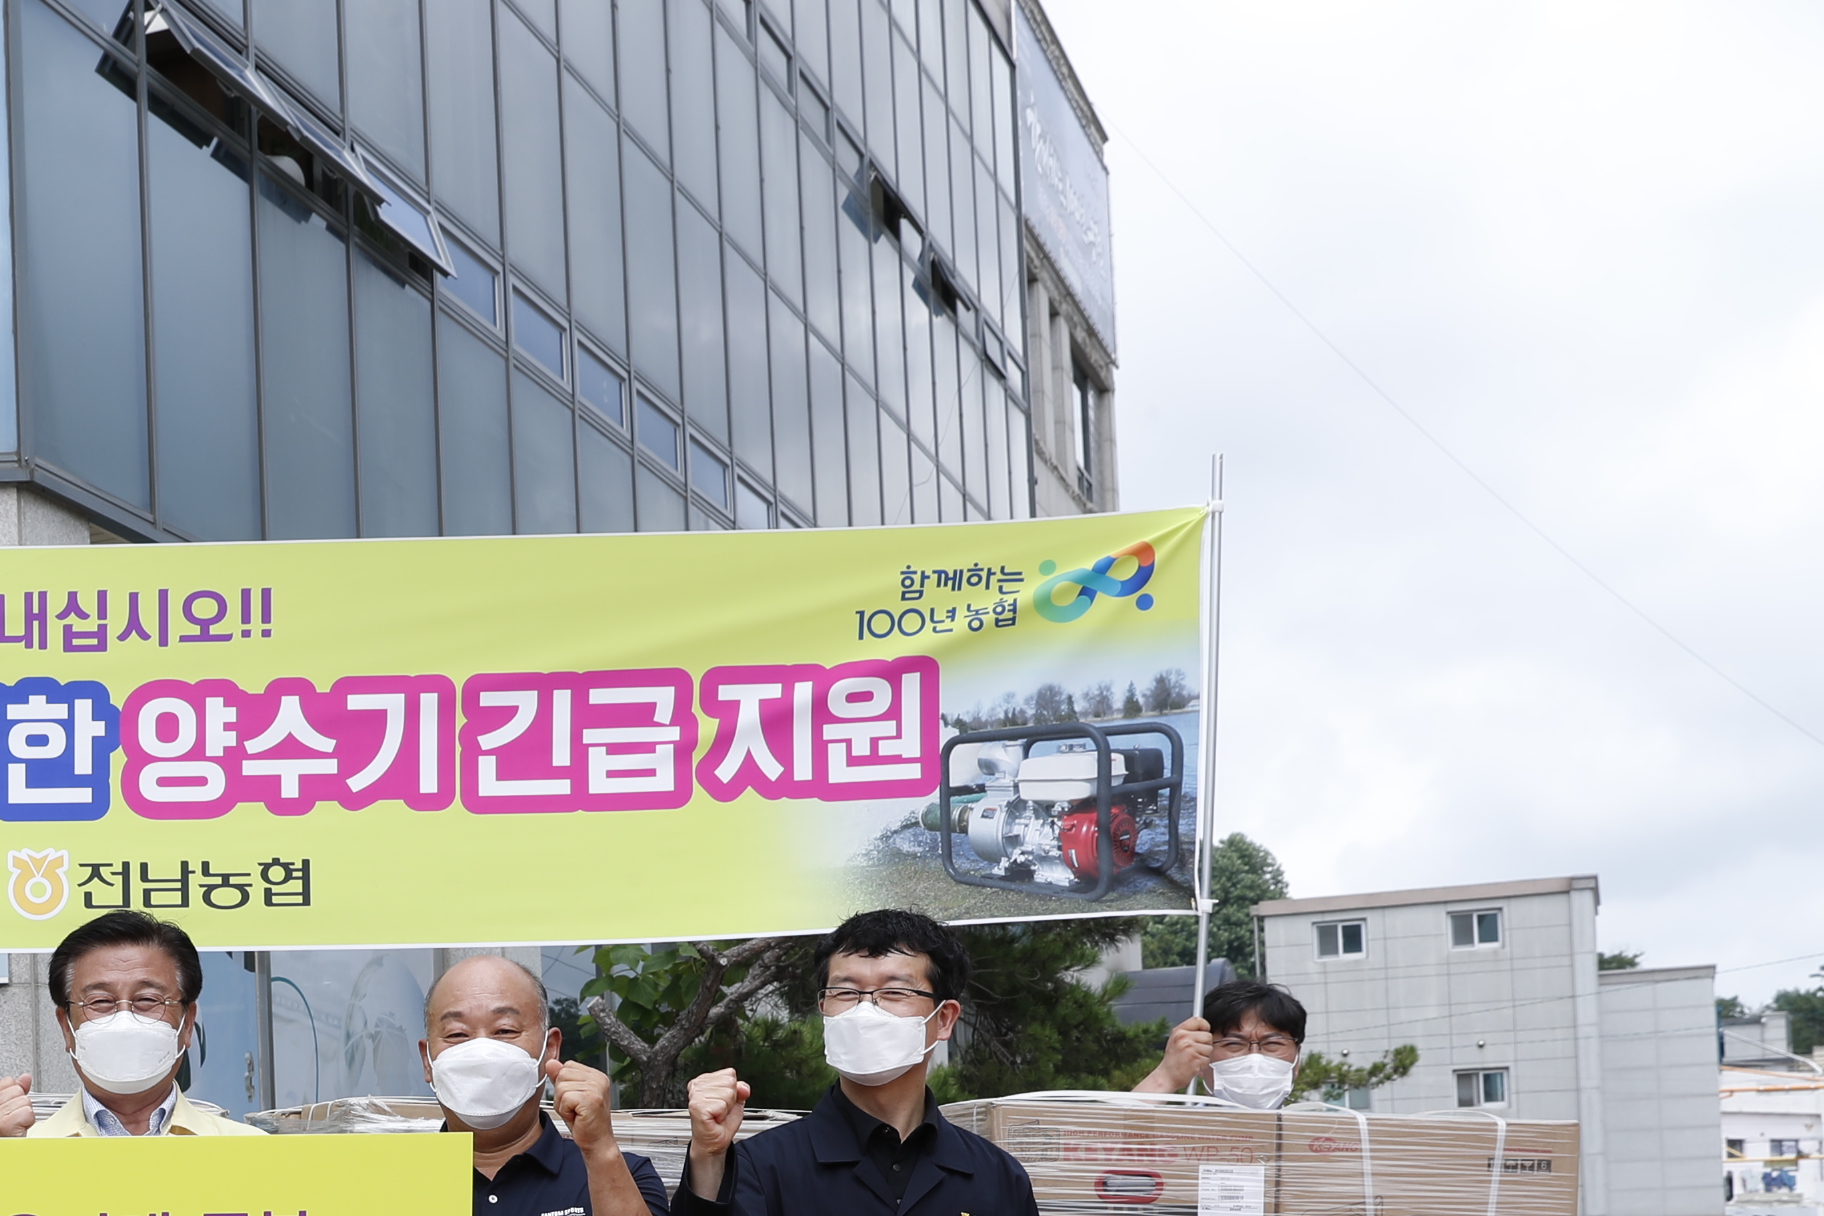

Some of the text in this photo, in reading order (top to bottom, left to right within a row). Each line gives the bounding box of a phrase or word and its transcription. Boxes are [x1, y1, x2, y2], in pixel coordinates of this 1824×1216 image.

[899, 562, 1025, 602] 함께하는
[855, 597, 1018, 642] 100년 농협
[135, 691, 440, 803] 양수기
[476, 685, 682, 798] 긴급
[713, 671, 924, 785] 지원
[76, 856, 313, 911] 전남농협
[1063, 1142, 1179, 1164] KEYANG
